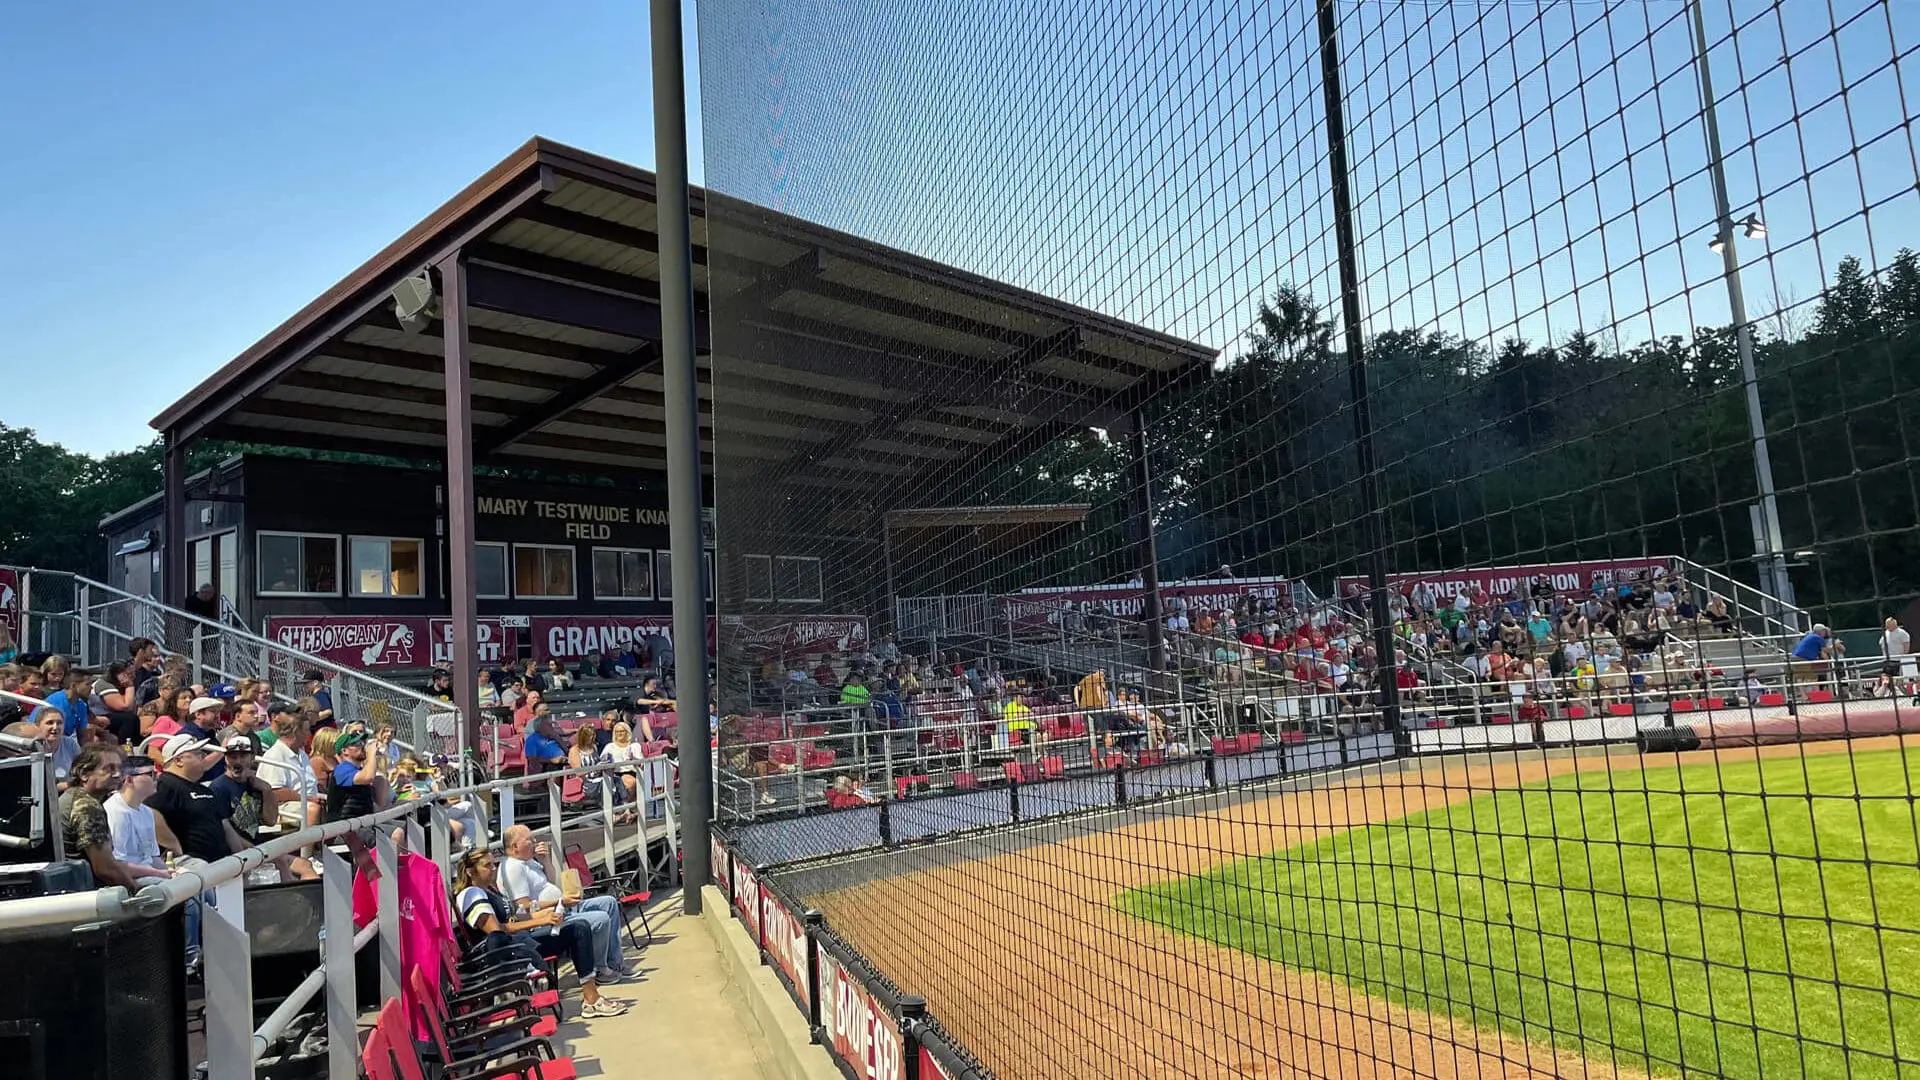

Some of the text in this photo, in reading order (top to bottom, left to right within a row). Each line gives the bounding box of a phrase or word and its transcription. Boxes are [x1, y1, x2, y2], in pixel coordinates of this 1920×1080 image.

[477, 497, 671, 525] MARY TESTWUIDE KNA
[566, 522, 611, 540] FIELD
[500, 616, 529, 626] Sec. 4
[277, 624, 381, 656] SHEBOYGAN
[444, 624, 492, 642] BD
[435, 643, 501, 662] LIHT
